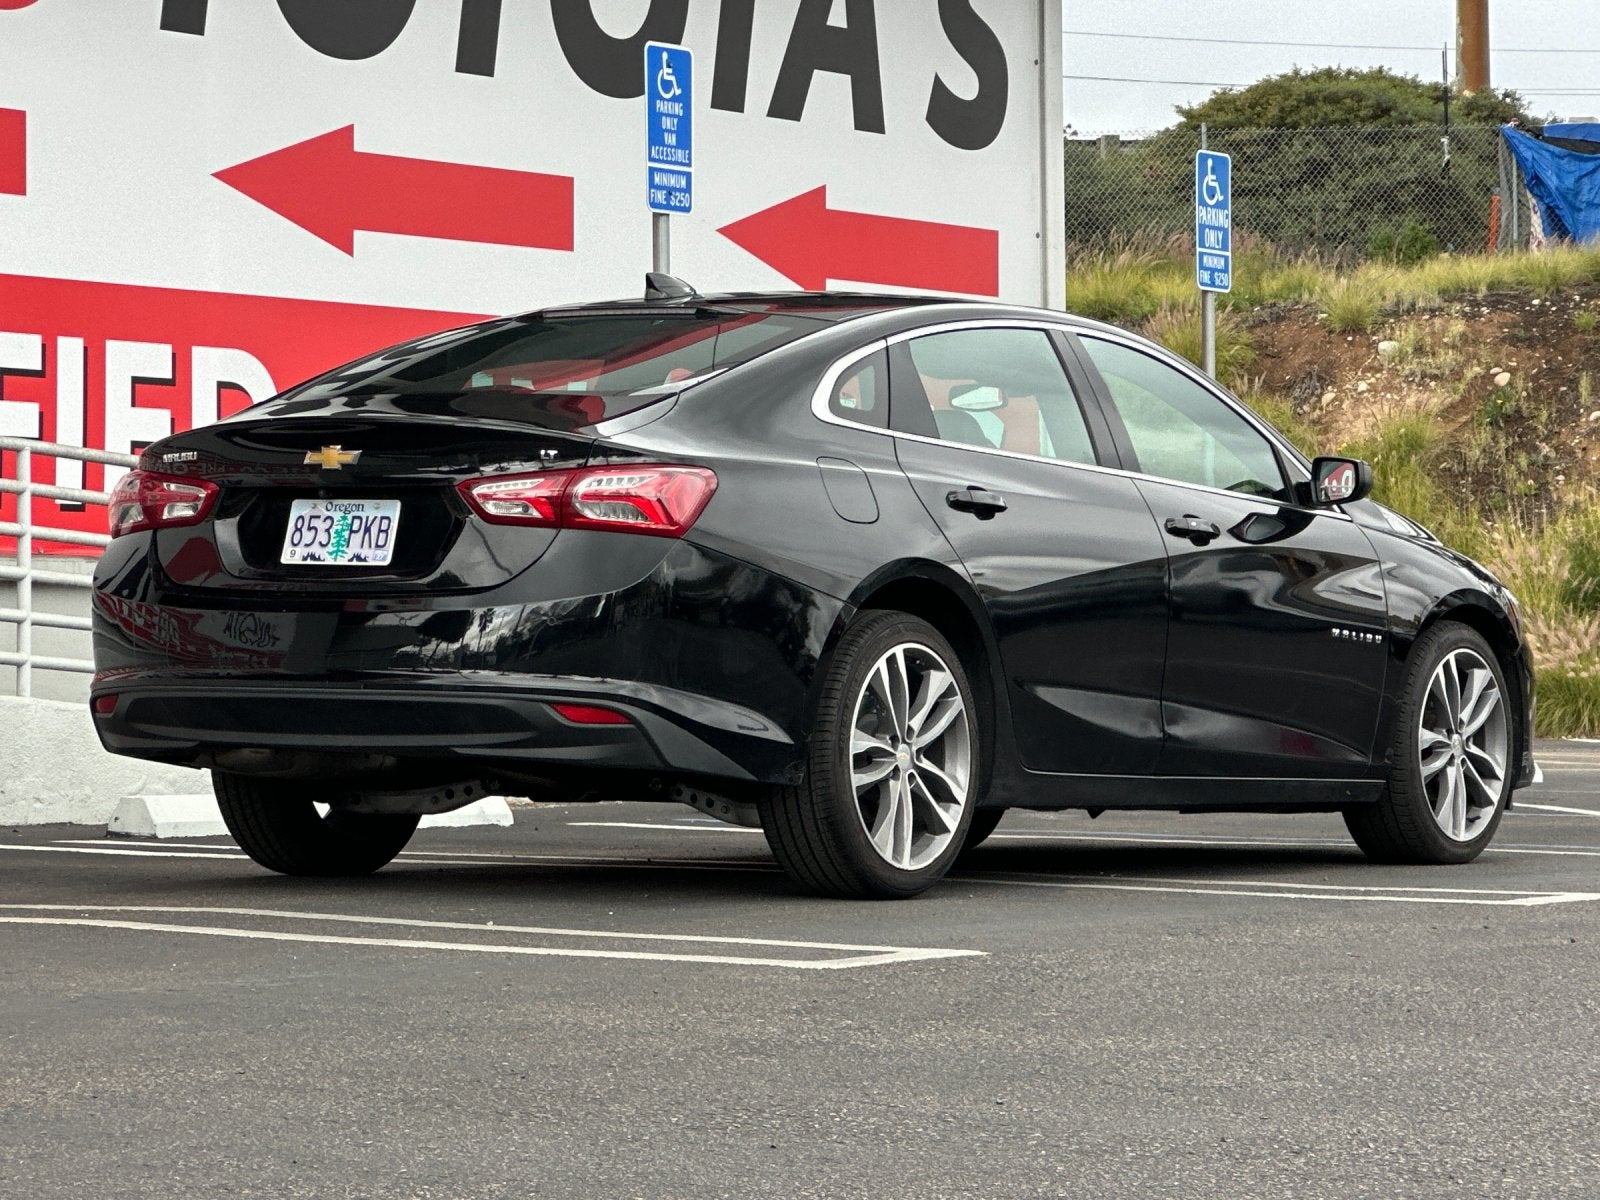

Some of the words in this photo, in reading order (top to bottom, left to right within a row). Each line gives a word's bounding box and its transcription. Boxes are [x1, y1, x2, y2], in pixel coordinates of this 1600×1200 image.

[656, 100, 683, 116] PARKING
[662, 117, 678, 131] ONLY
[664, 132, 677, 146] VAN
[651, 146, 689, 163] ACCESSIBLE
[654, 172, 686, 189] MINIMUM
[650, 189, 667, 205] FINE
[670, 192, 690, 208] $250
[1199, 206, 1228, 228] PARKING
[1205, 228, 1222, 248] ONLY
[1203, 256, 1224, 270] MINIMUM
[1200, 270, 1211, 284] FINE
[1214, 272, 1228, 286] $250
[162, 451, 198, 463] MALIBU
[540, 449, 559, 460] LT
[325, 501, 365, 514] Oregon
[290, 515, 335, 547] 853
[346, 515, 392, 549] PKB
[1331, 628, 1382, 643] MALIBU
